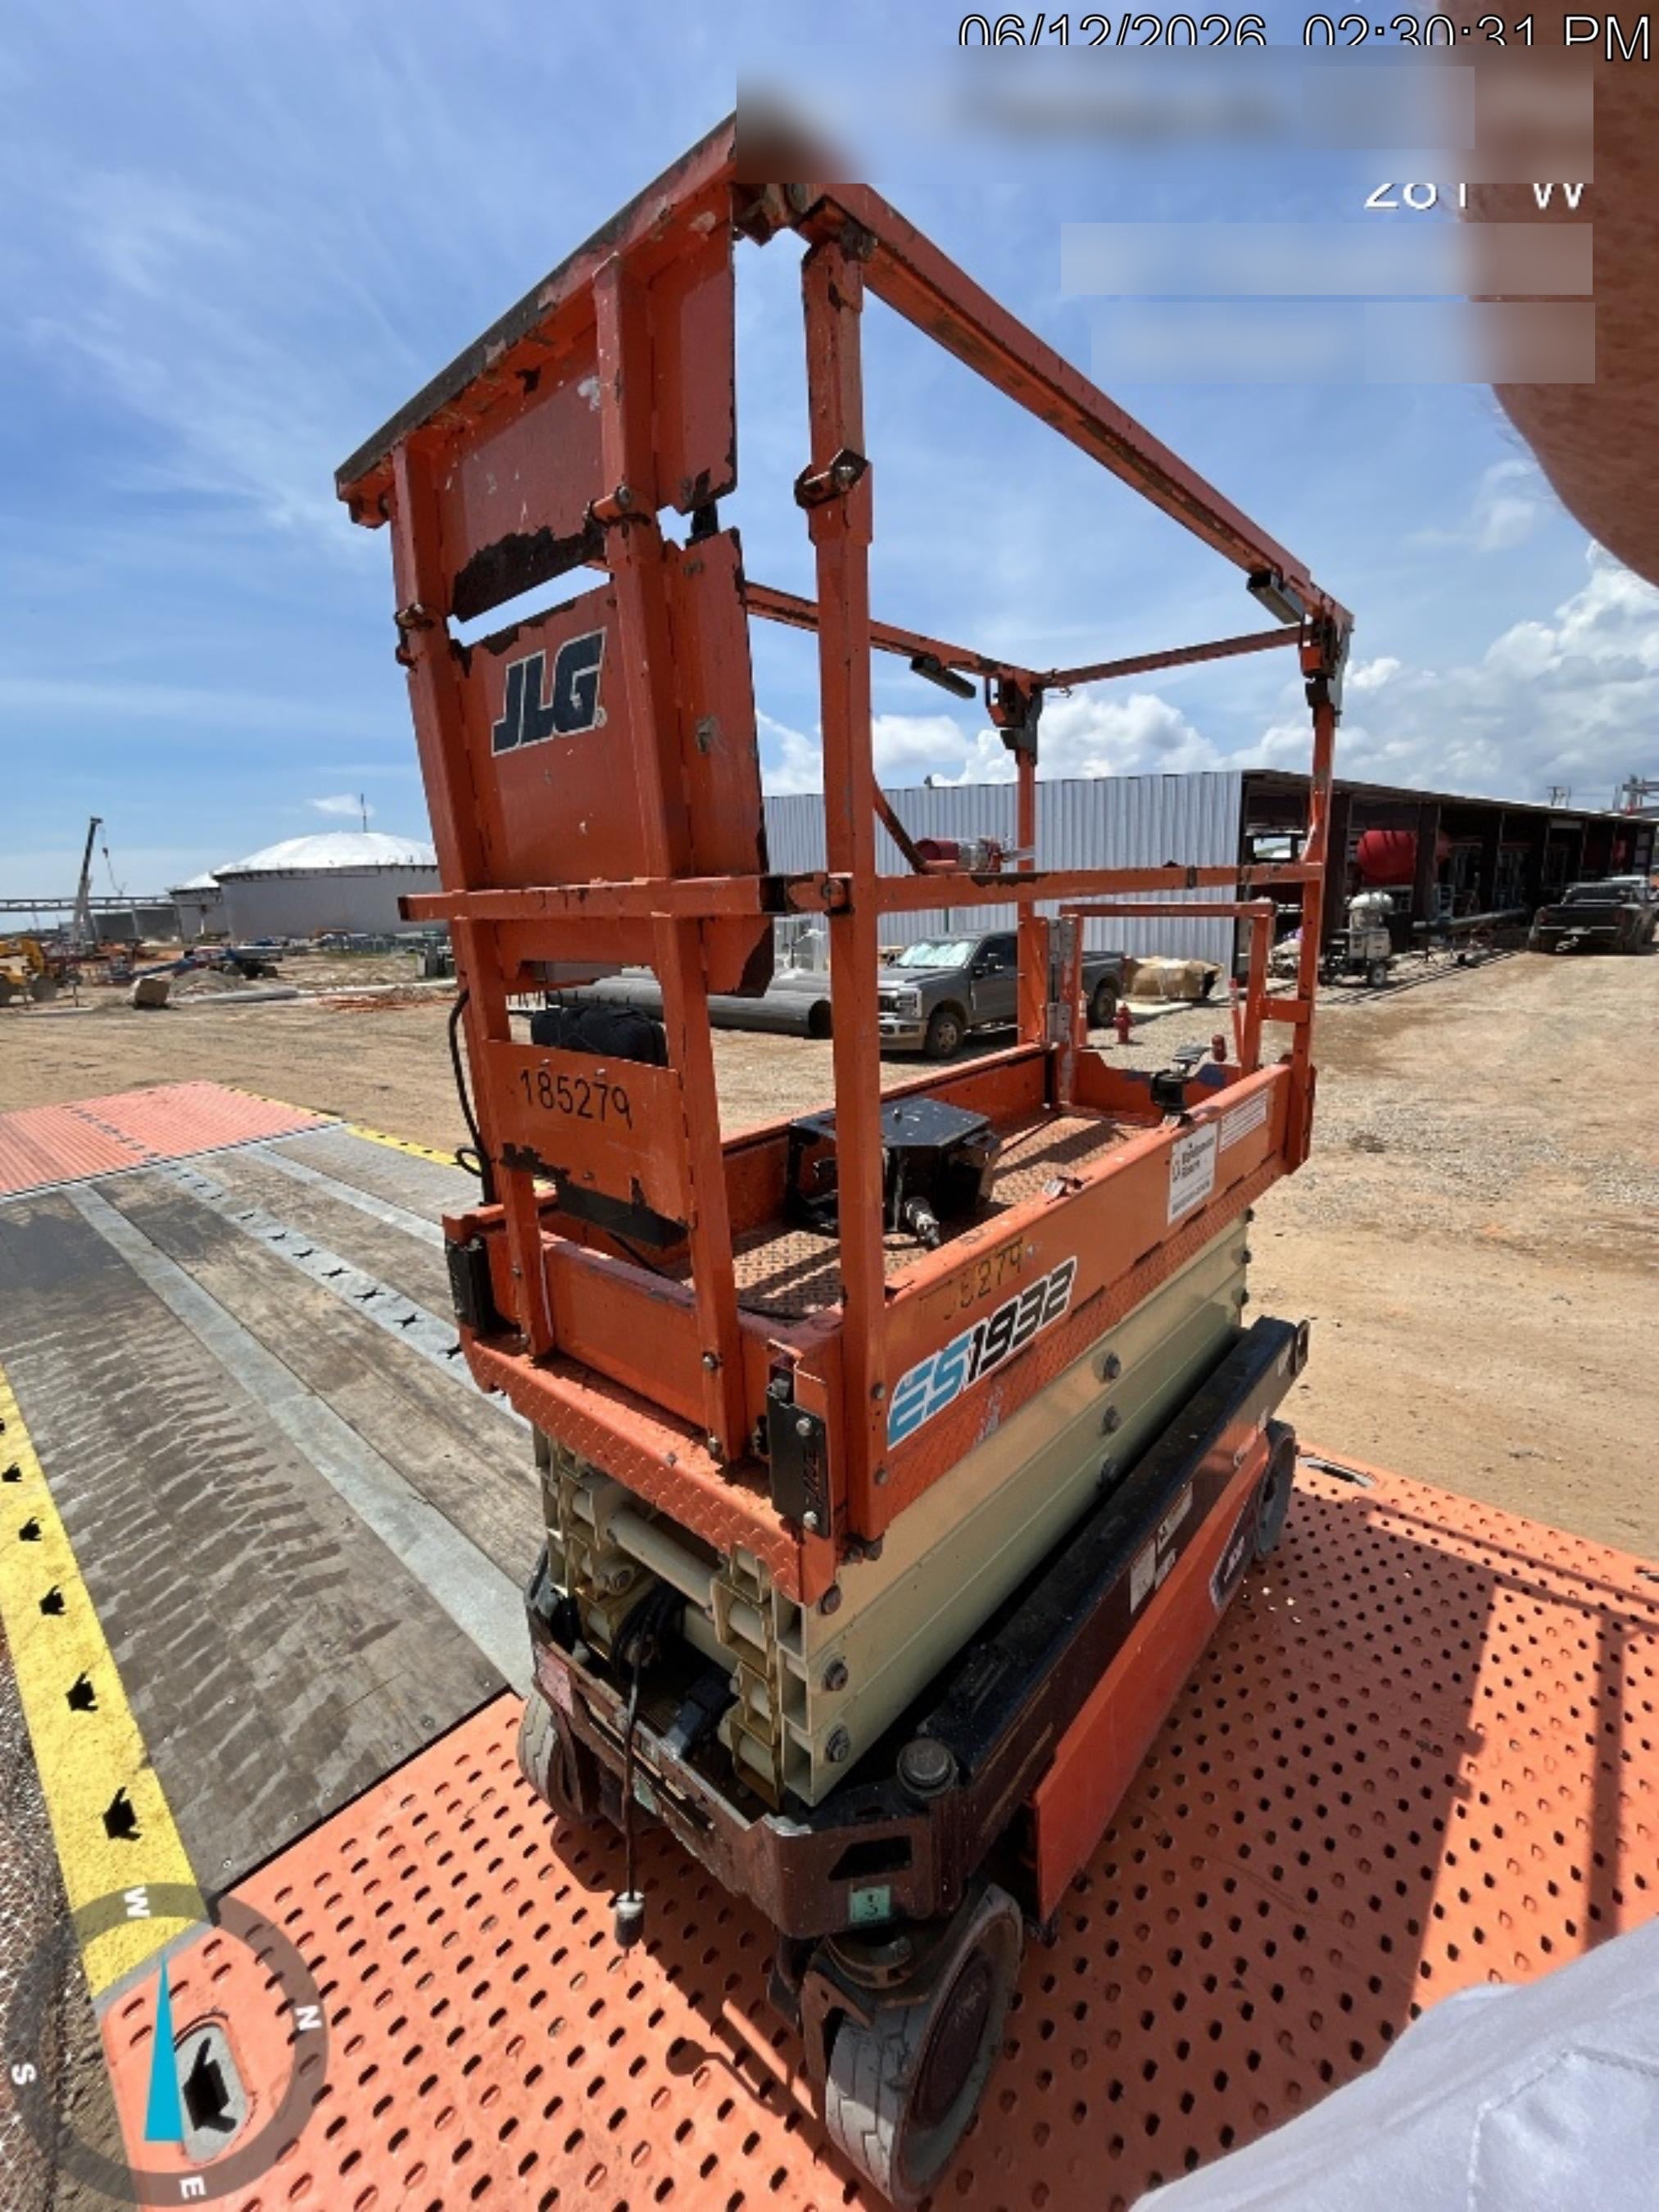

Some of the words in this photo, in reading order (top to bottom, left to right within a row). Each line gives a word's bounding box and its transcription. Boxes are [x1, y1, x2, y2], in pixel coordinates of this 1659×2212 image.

[492, 627, 607, 757] JLG
[520, 1068, 632, 1131] 185279
[887, 1255, 1077, 1451] ES1932
